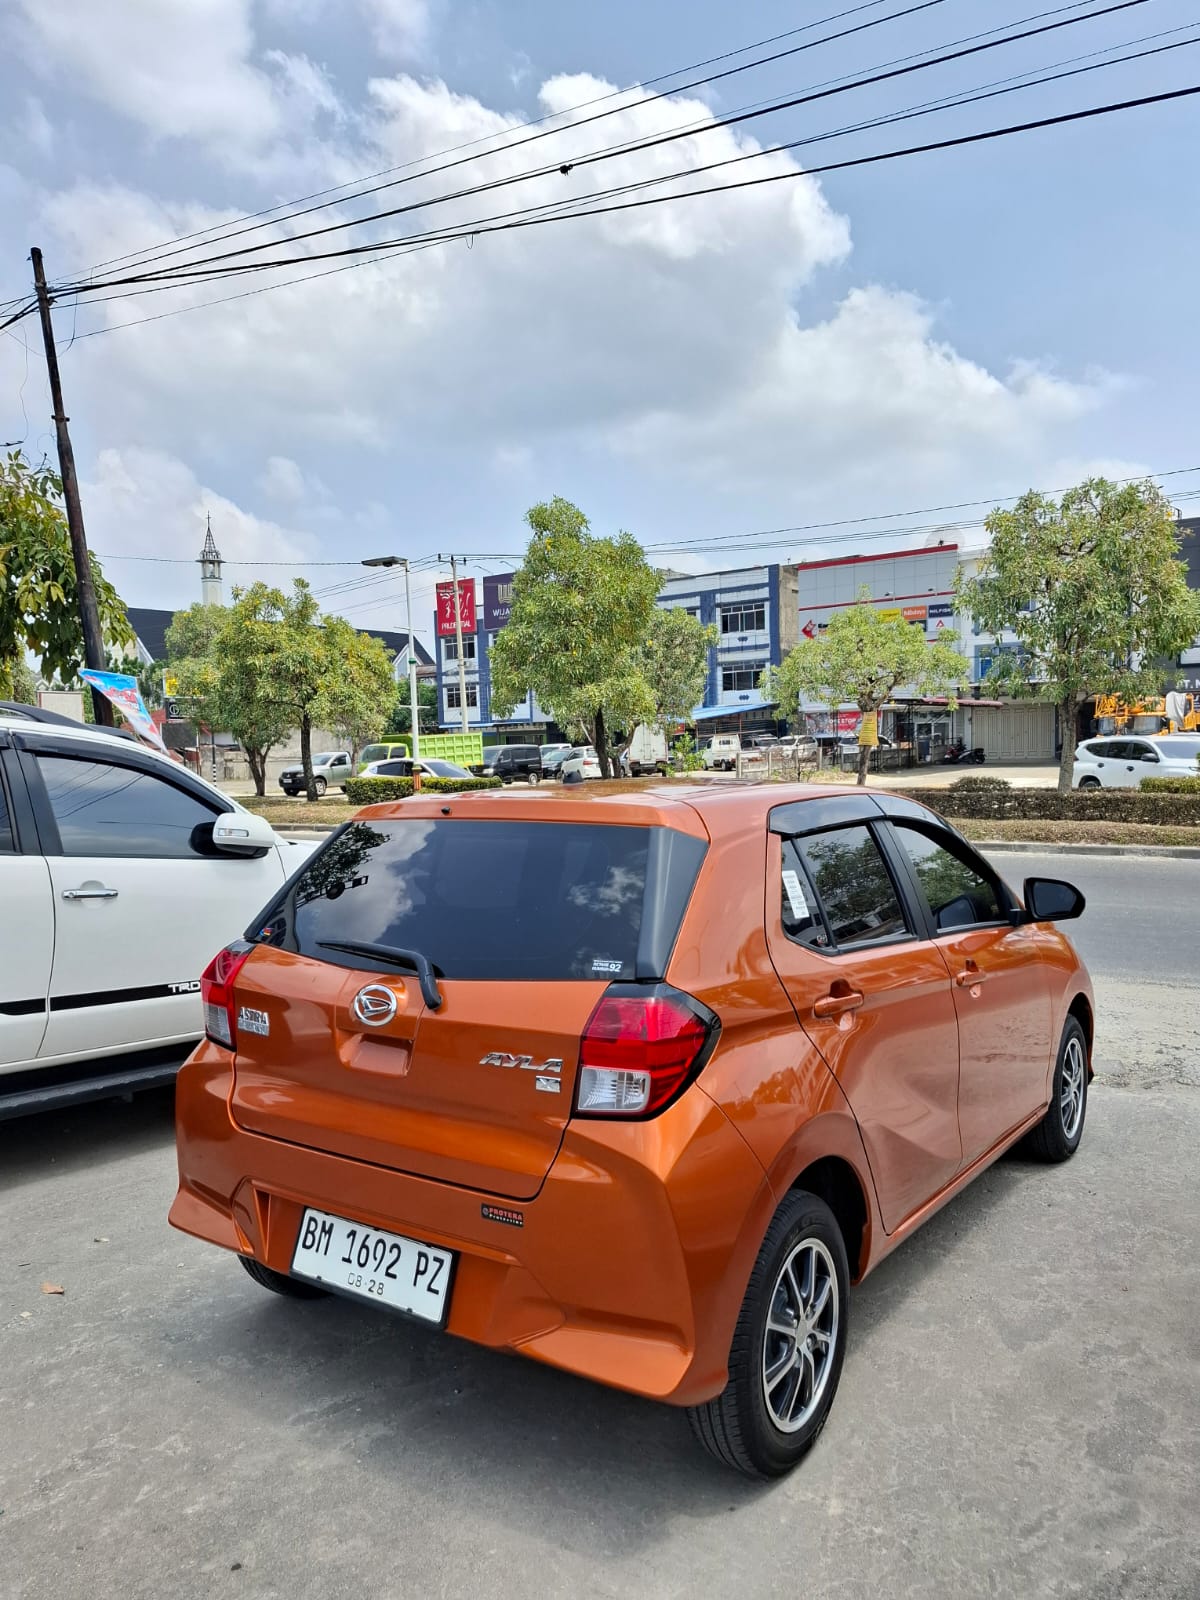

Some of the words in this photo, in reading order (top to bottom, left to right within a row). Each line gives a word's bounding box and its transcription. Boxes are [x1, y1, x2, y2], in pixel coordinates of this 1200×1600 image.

[609, 963, 622, 972] 92
[168, 981, 201, 993] TRD
[238, 1006, 268, 1025] ASTRA
[479, 1051, 563, 1072] AYLA
[489, 1207, 522, 1220] PROTERA
[301, 1216, 334, 1256] BM
[341, 1229, 401, 1280] 1692
[413, 1251, 445, 1295] PZ
